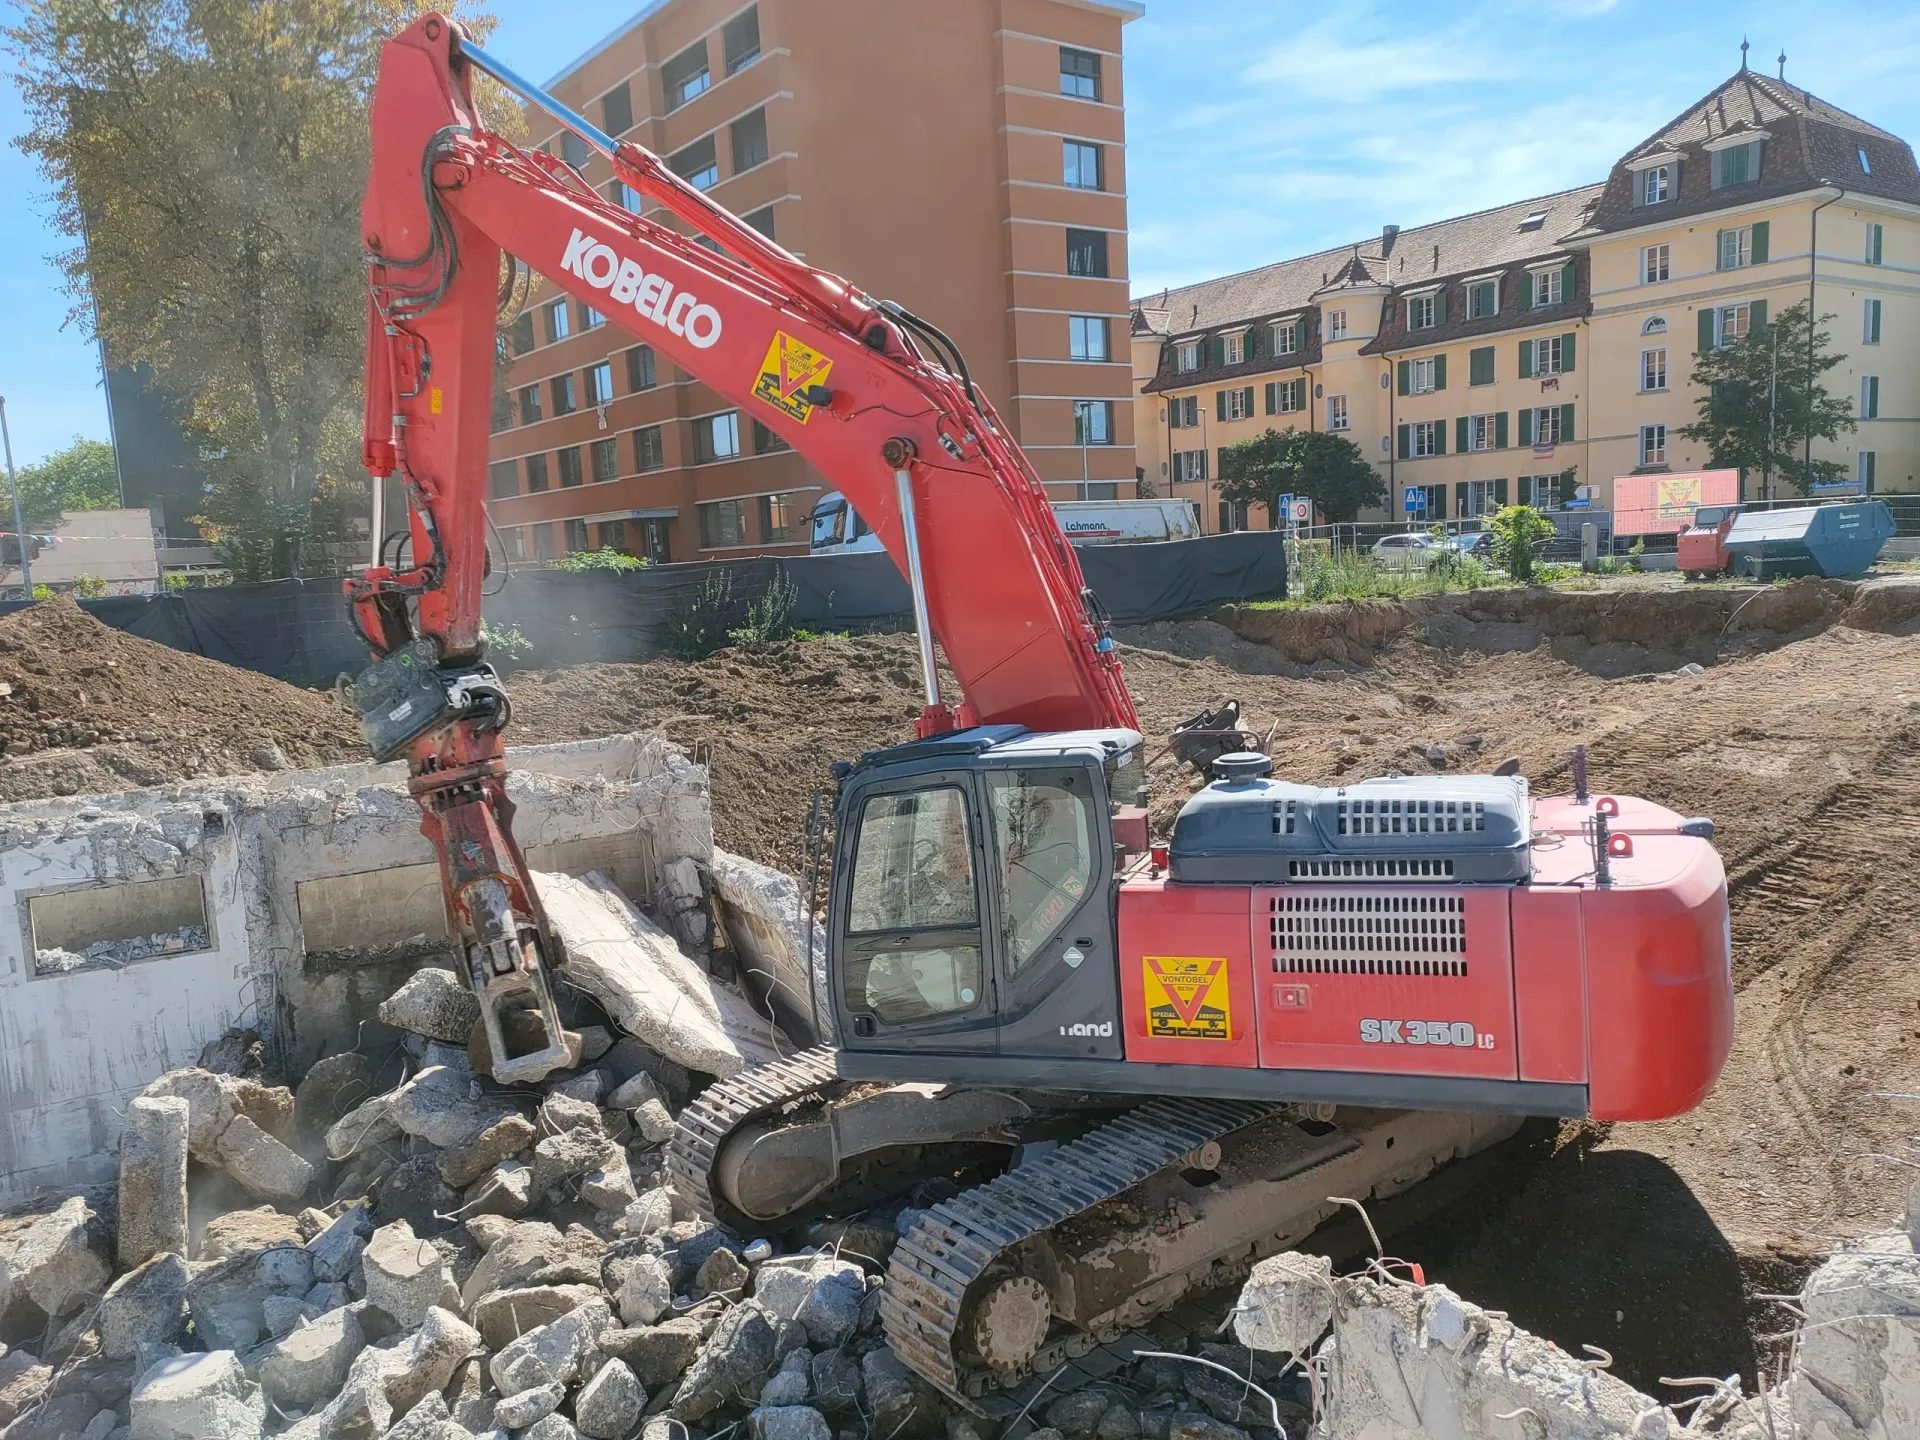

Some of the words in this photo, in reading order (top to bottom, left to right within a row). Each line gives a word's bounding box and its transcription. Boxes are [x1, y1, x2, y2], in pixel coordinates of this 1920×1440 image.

[560, 227, 722, 348] KOBELCO
[782, 351, 815, 374] VONTOBEL
[1065, 521, 1107, 531] Lehmann
[1162, 975, 1209, 984] VONTOBEL
[1359, 1017, 1475, 1047] SK350
[1477, 1033, 1495, 1049] LC
